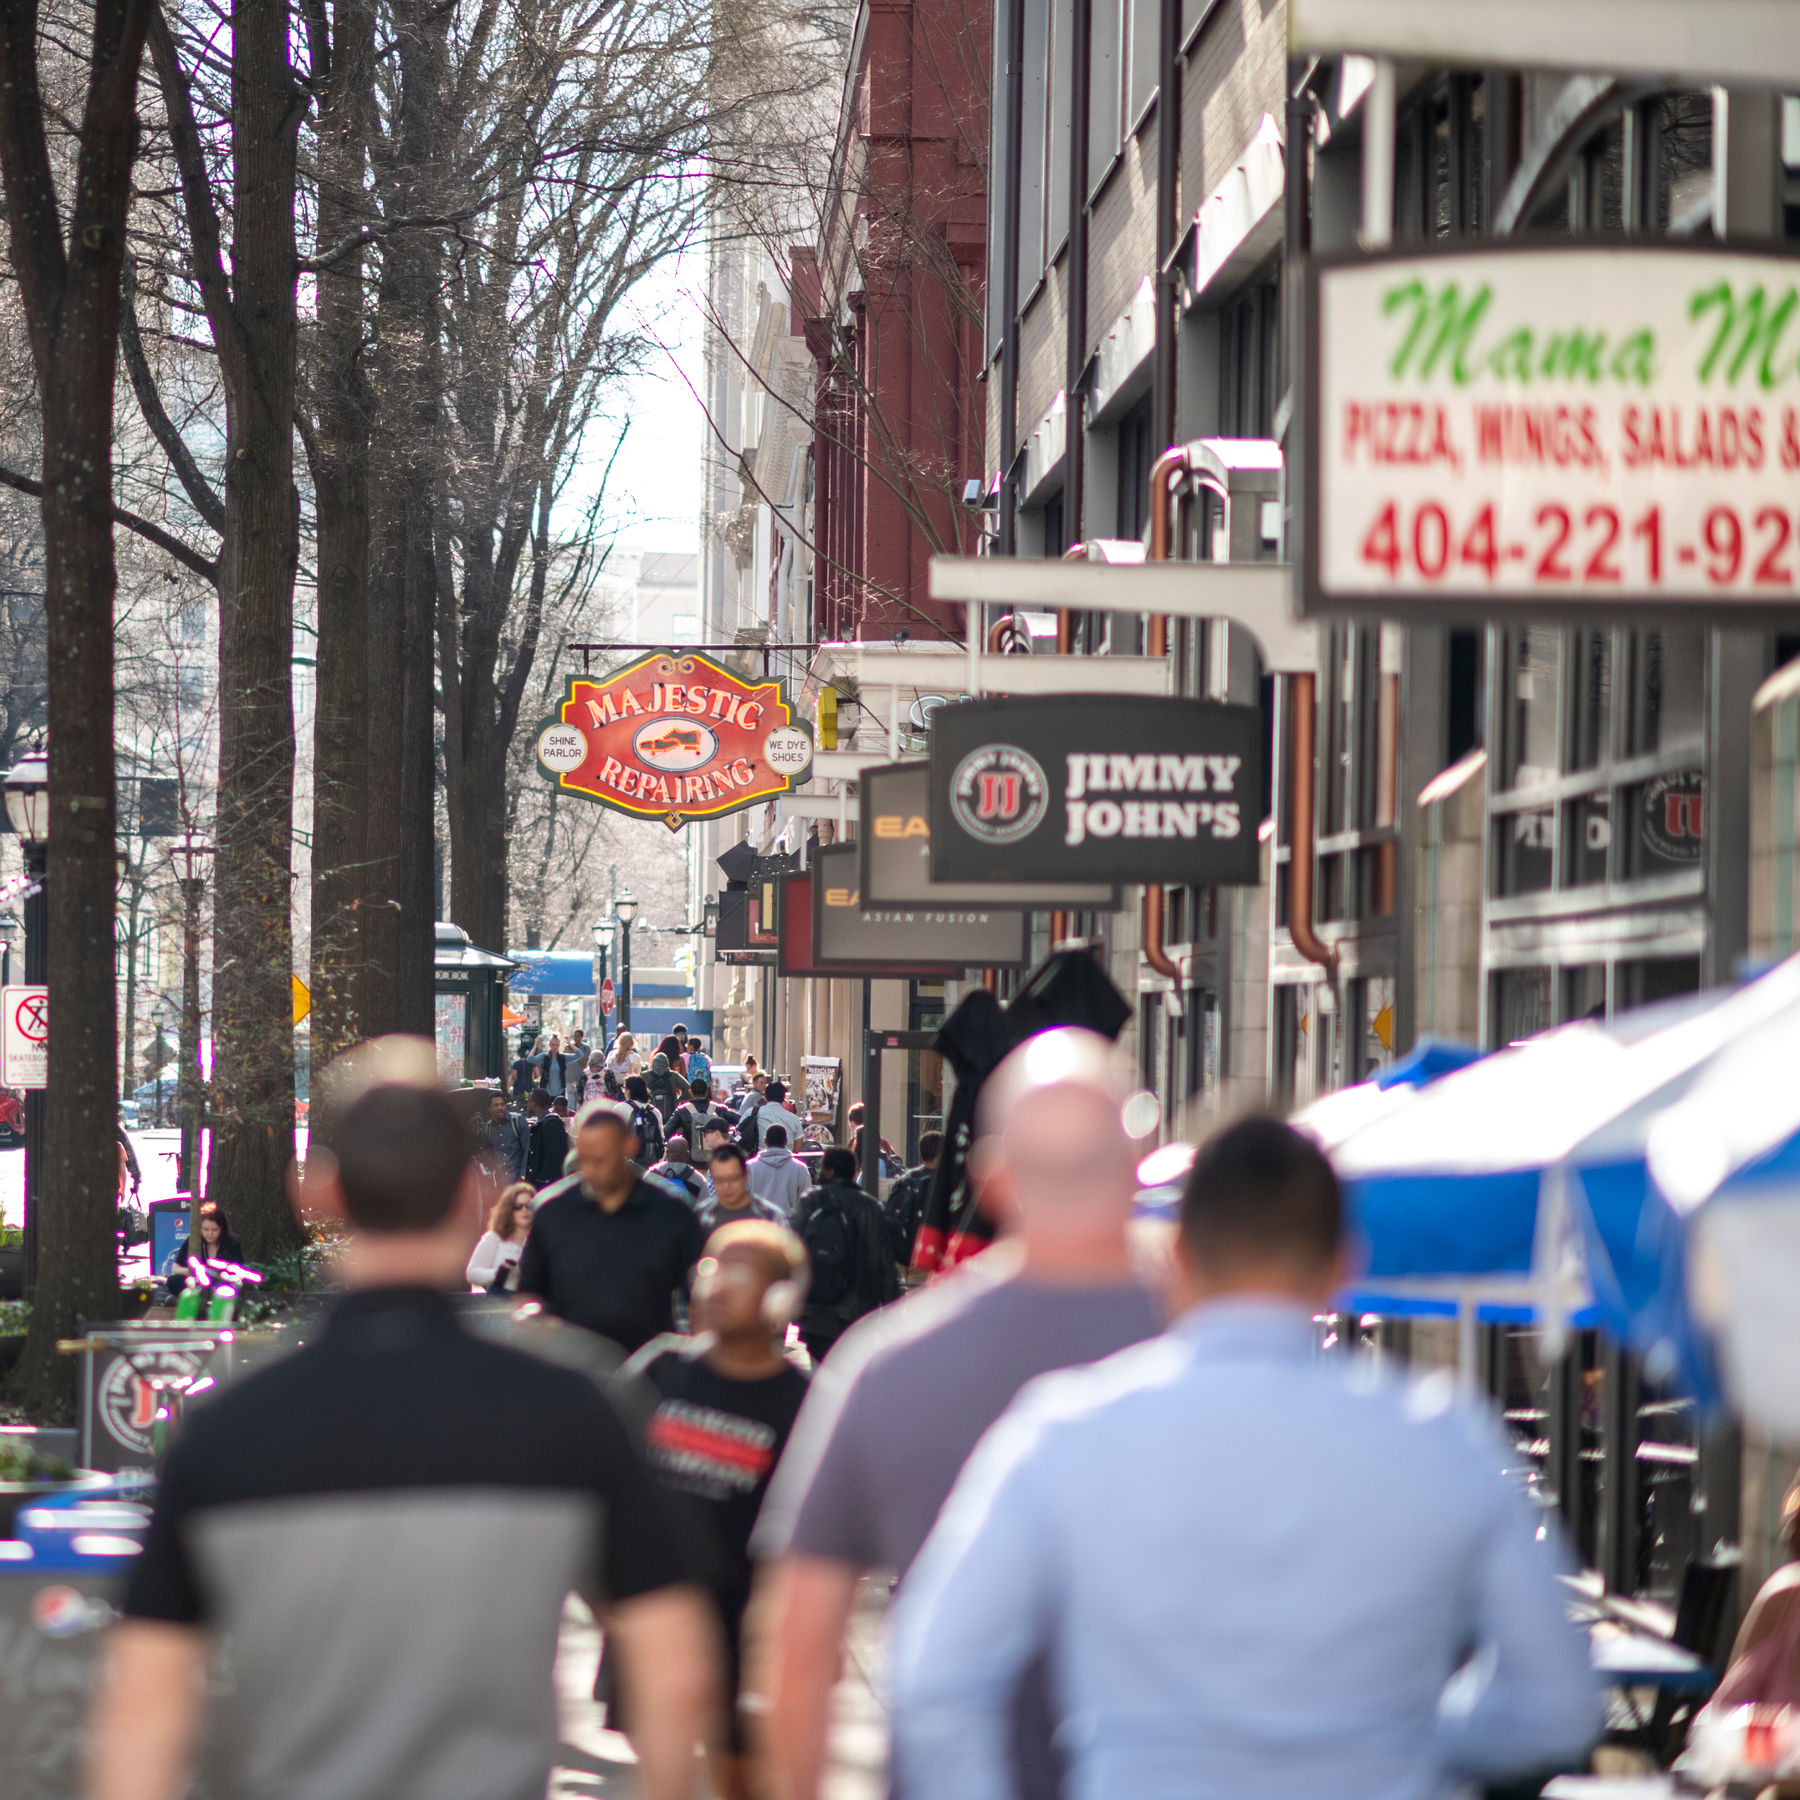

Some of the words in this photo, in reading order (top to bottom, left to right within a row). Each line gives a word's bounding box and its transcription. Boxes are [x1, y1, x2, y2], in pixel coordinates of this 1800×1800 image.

[1381, 278, 1655, 388] Mama
[1686, 278, 1800, 391] M
[1343, 401, 1463, 475] PIZZA,
[1474, 404, 1608, 480] WINGS,
[1621, 405, 1765, 469] SALADS
[1360, 499, 1800, 586] 404-221-92
[585, 682, 764, 731] MAJESTIC
[543, 748, 582, 759] PARLOR
[549, 736, 576, 746] SHINE
[769, 740, 785, 750] WE
[787, 741, 806, 750] DYE
[771, 753, 804, 762] SHOES
[600, 755, 755, 804] REPAIRING
[977, 771, 1022, 820] JJ
[1065, 753, 1241, 799] JIMMY
[1065, 800, 1241, 846] JOHN'S
[863, 912, 914, 922] ASIAN
[925, 912, 989, 924] FUSION
[602, 990, 615, 1004] STOP
